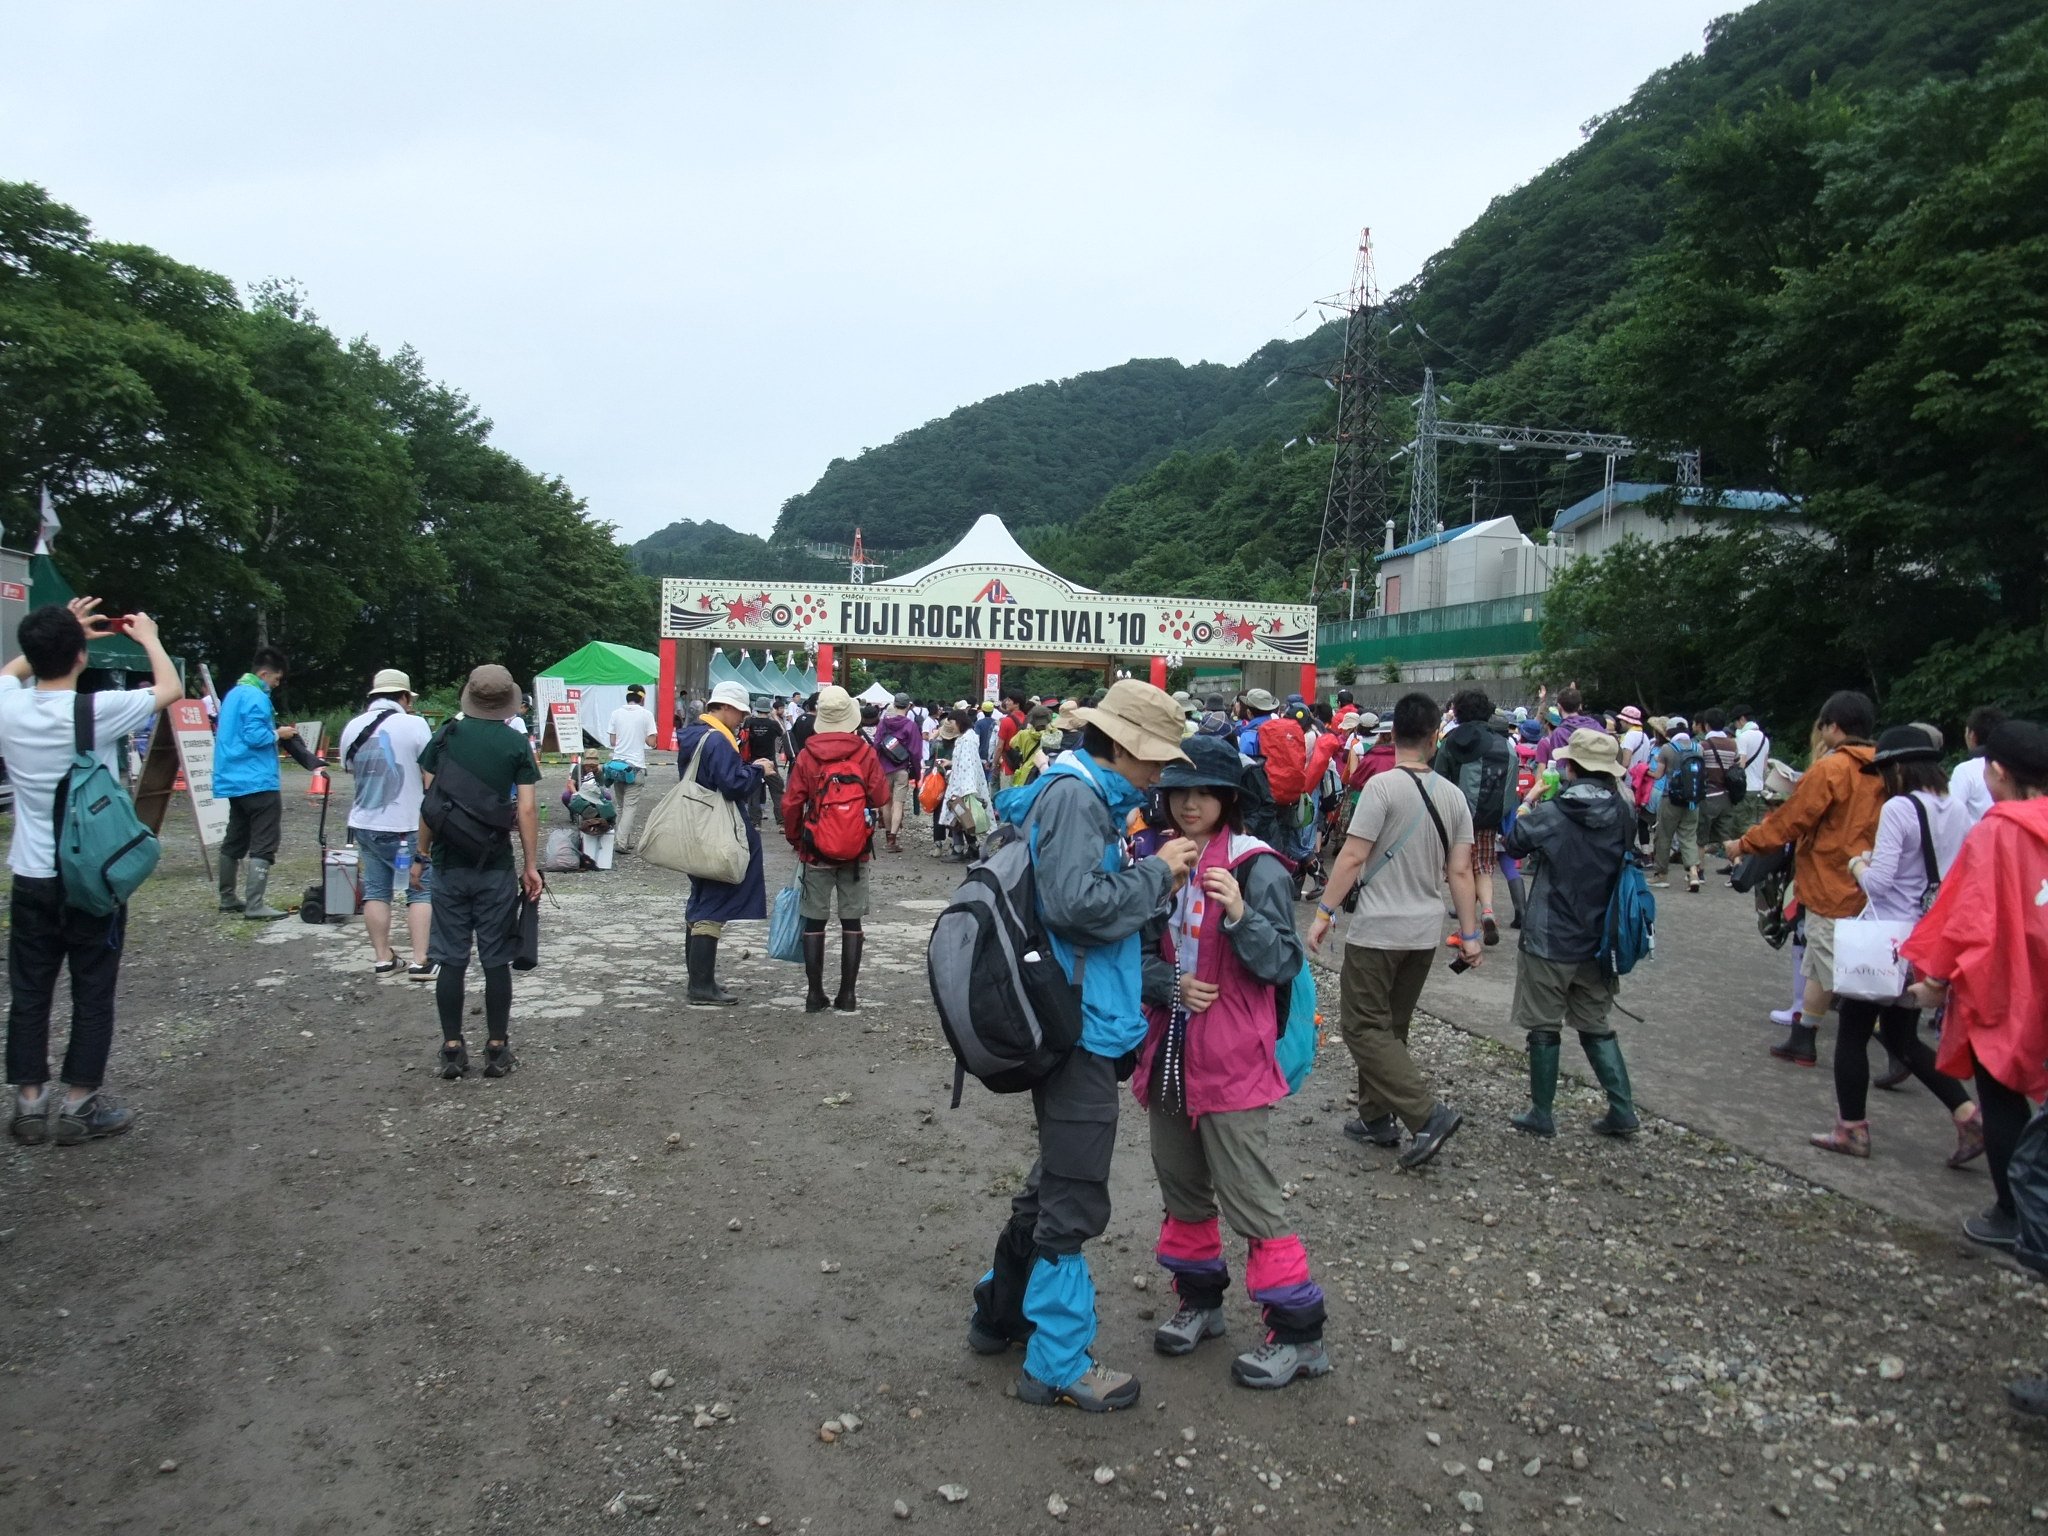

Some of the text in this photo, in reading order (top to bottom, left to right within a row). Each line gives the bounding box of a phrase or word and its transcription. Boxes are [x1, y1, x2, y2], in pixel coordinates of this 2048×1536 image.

[840, 601, 900, 636] FUJI
[908, 604, 982, 640] ROCK
[1836, 967, 1896, 976] CLARINS
